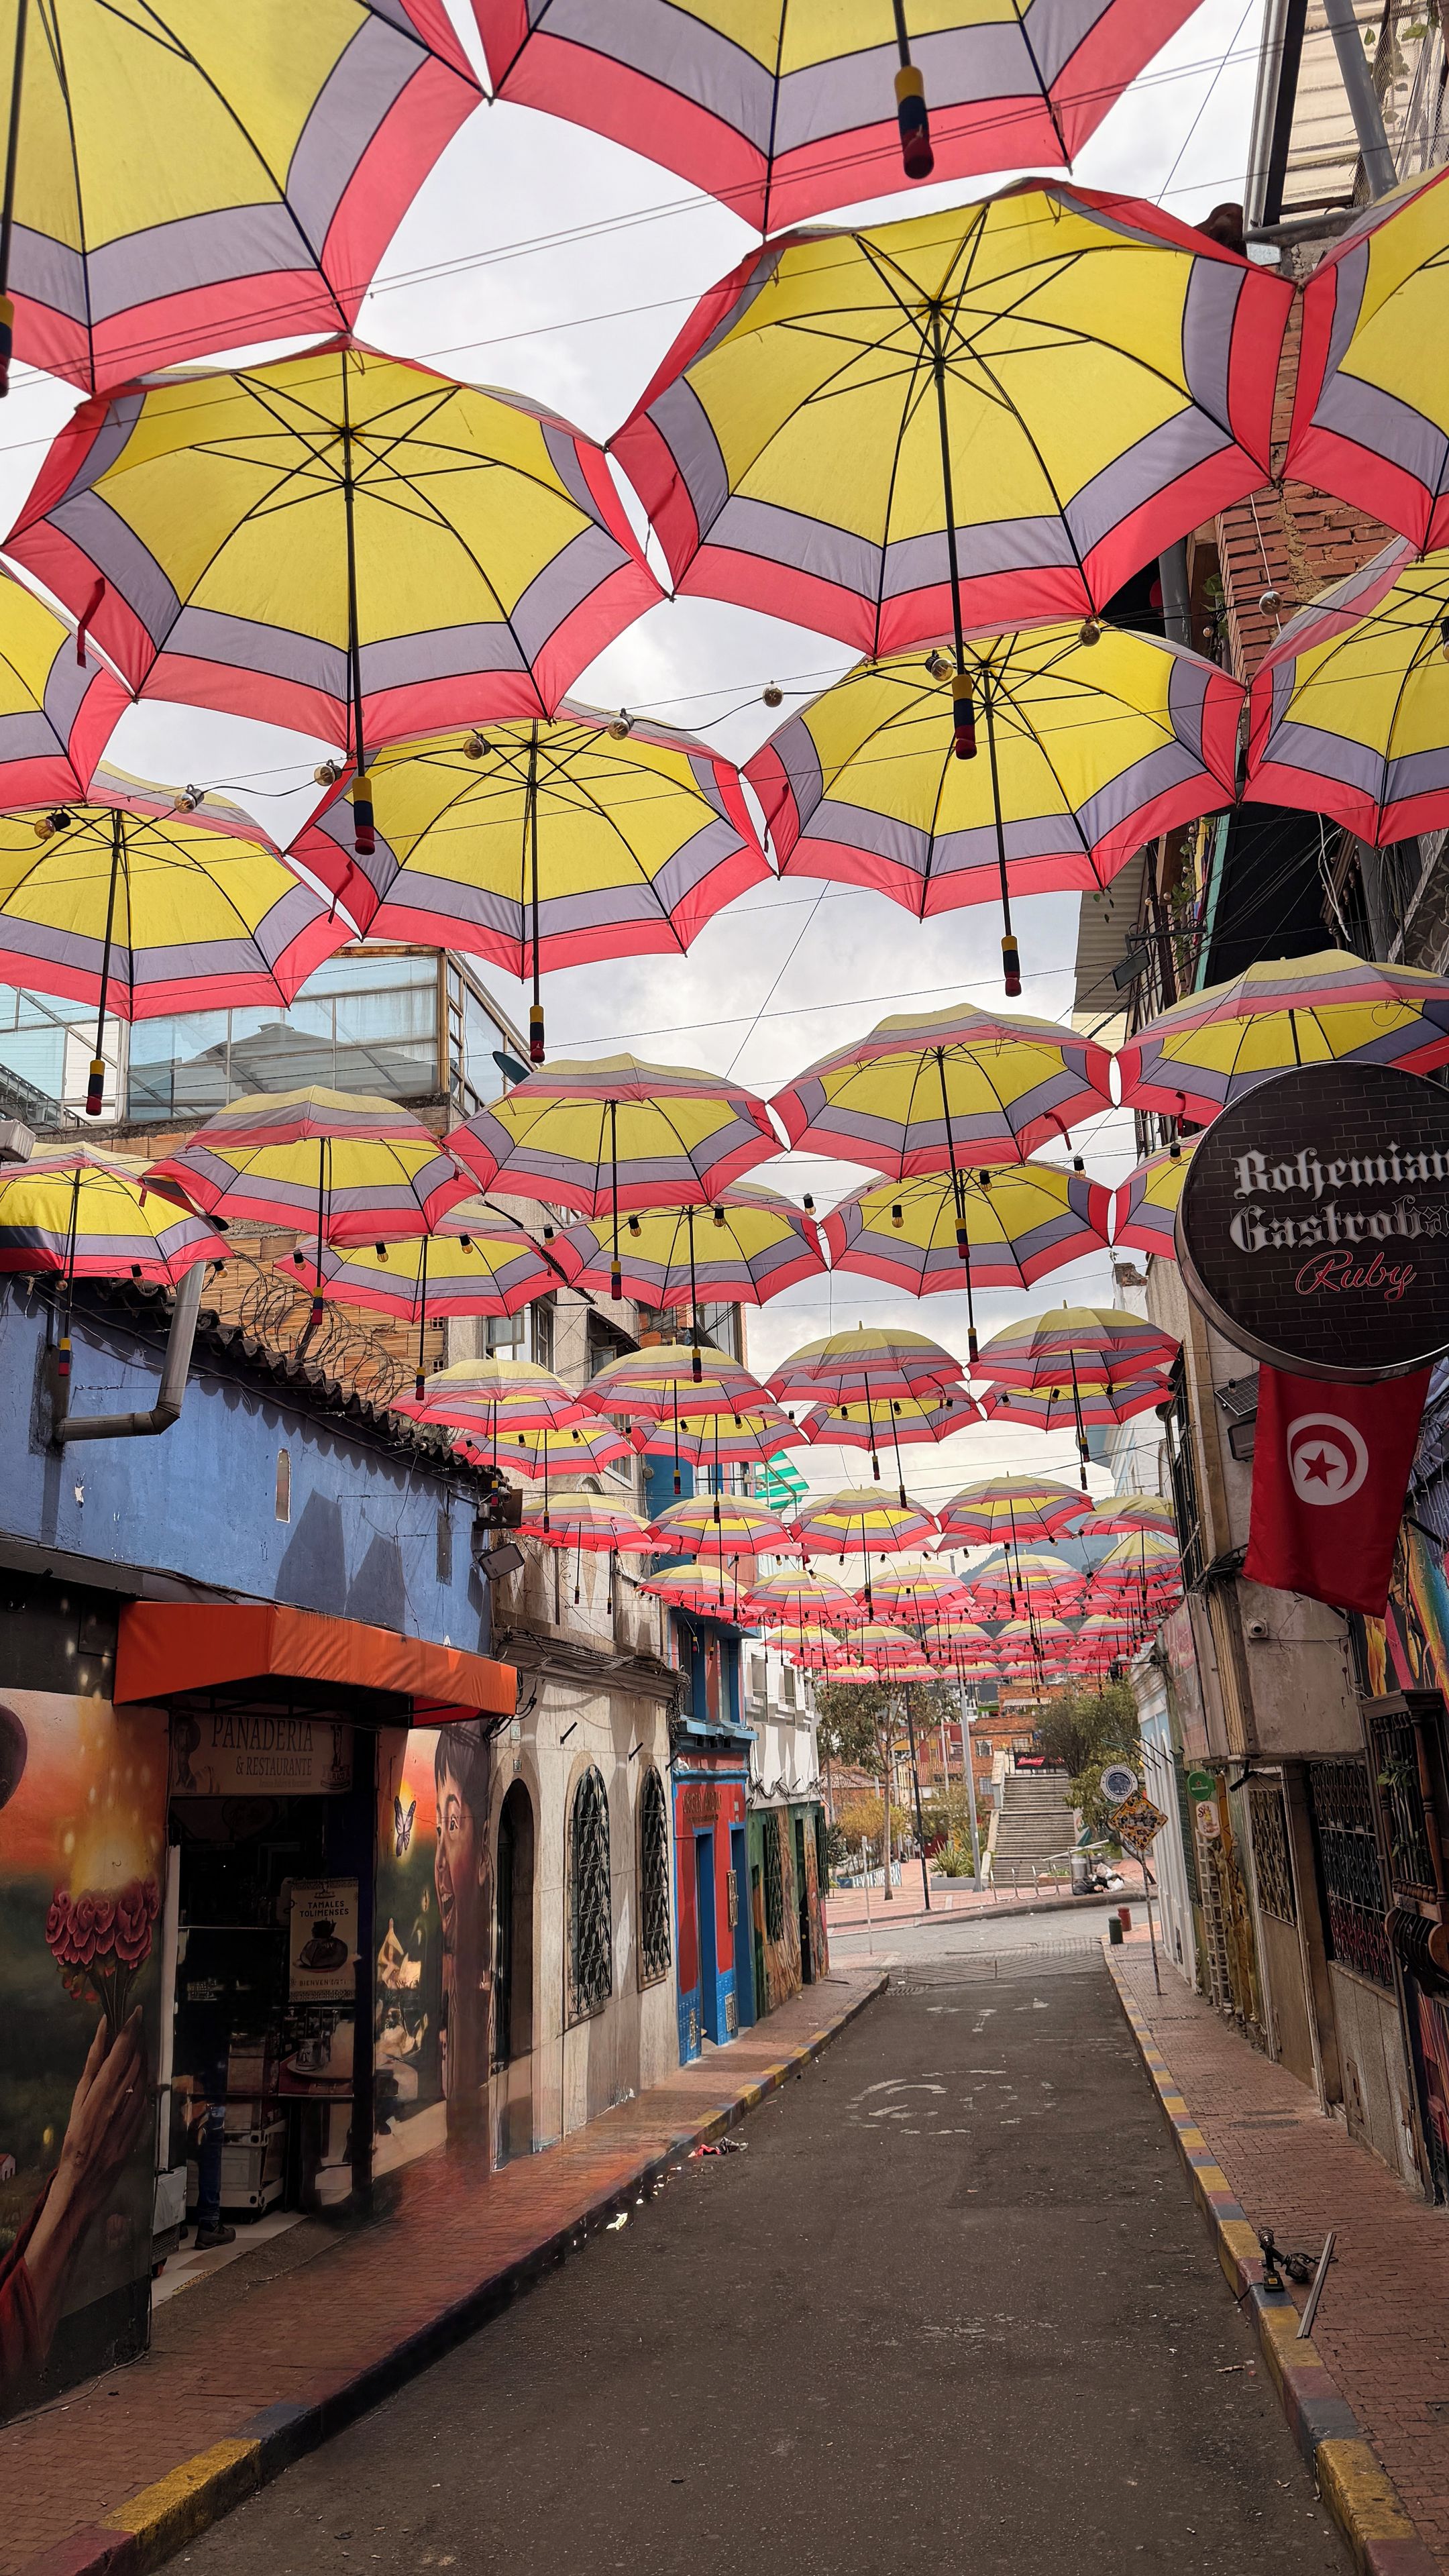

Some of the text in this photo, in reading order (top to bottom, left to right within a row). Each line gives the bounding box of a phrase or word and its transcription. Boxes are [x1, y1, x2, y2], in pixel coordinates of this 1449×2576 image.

[1231, 1140, 1449, 1201] Bohemian
[1230, 1195, 1449, 1252] Gastroba
[1295, 1250, 1417, 1301] Ruby
[236, 1756, 312, 1776] & RESTAURANTE
[300, 1908, 349, 1917] TOLIMENSES
[308, 1900, 344, 1909] TAMALES
